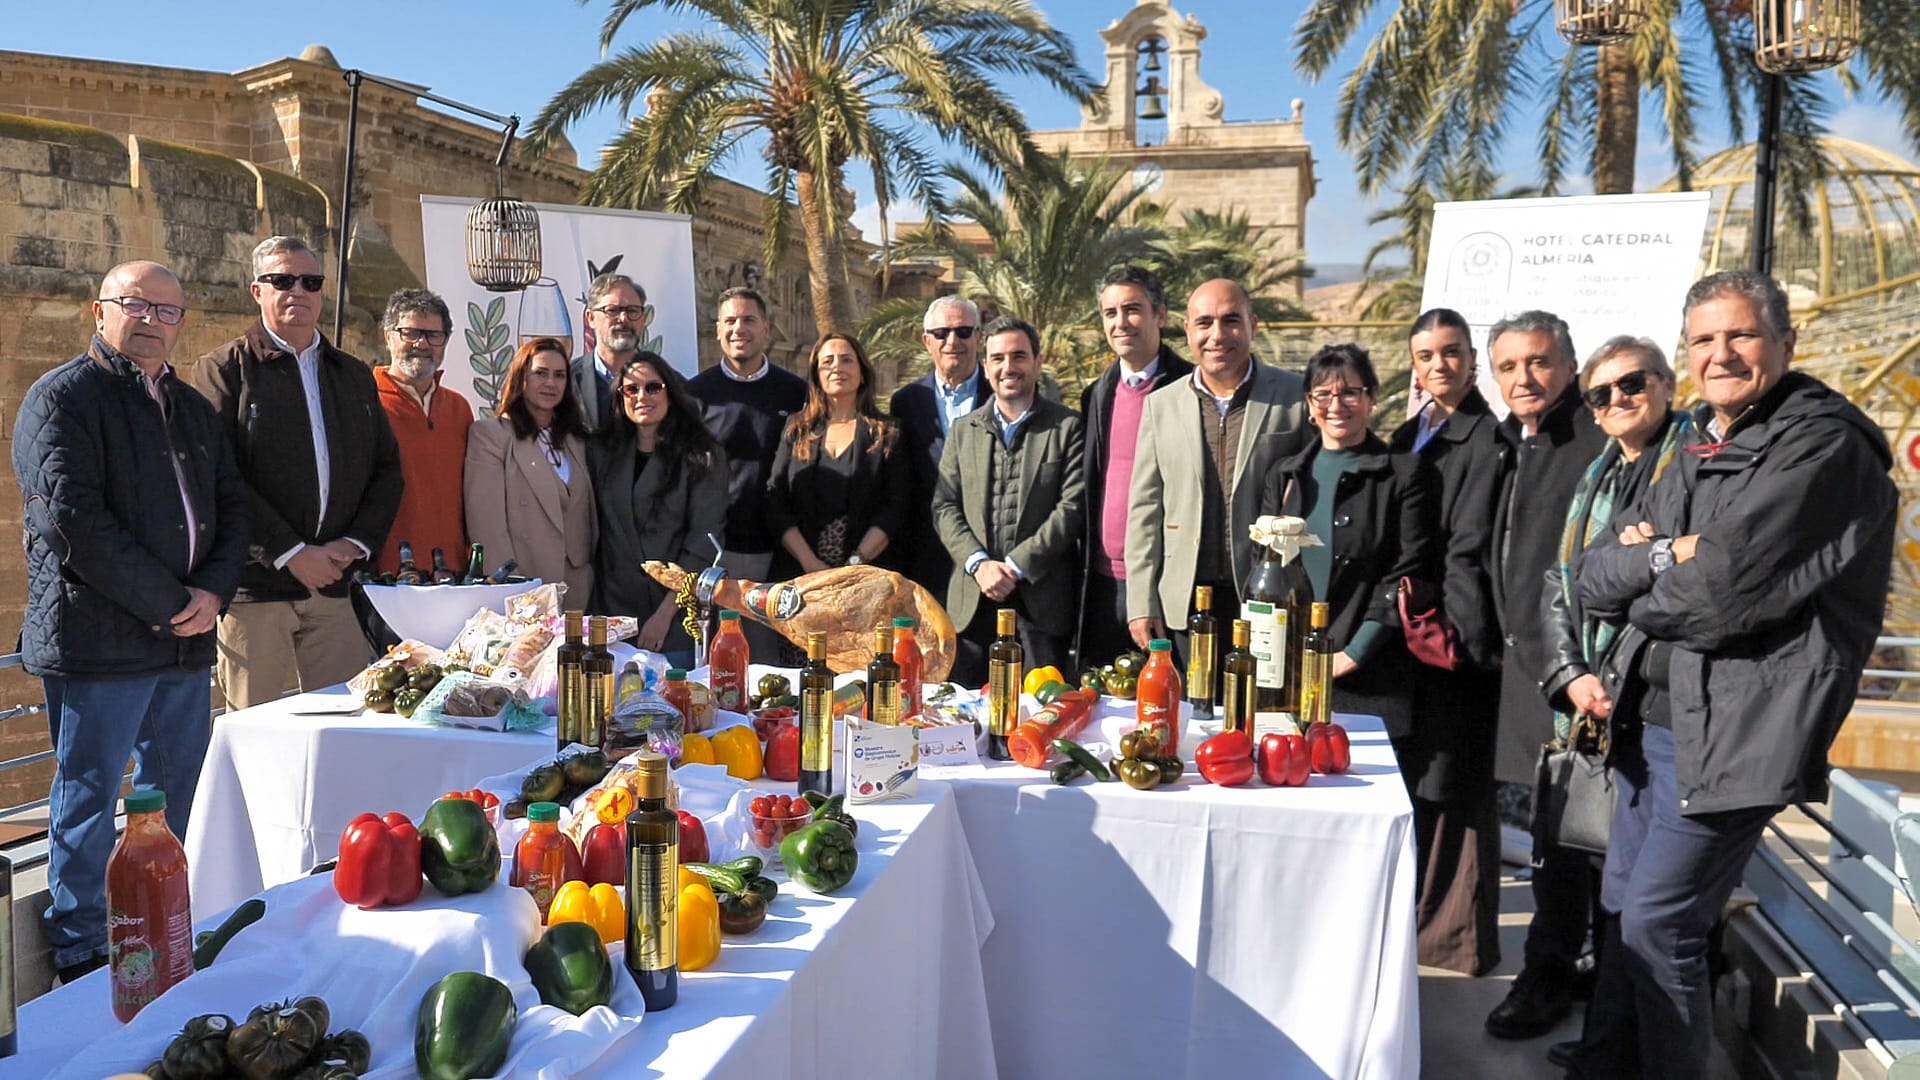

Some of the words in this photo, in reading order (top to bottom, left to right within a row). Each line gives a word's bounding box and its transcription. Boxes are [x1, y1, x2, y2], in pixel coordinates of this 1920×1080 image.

[1523, 234, 1572, 247] HOTE
[1581, 233, 1673, 246] CATEDRAL
[109, 914, 144, 929] Sabor
